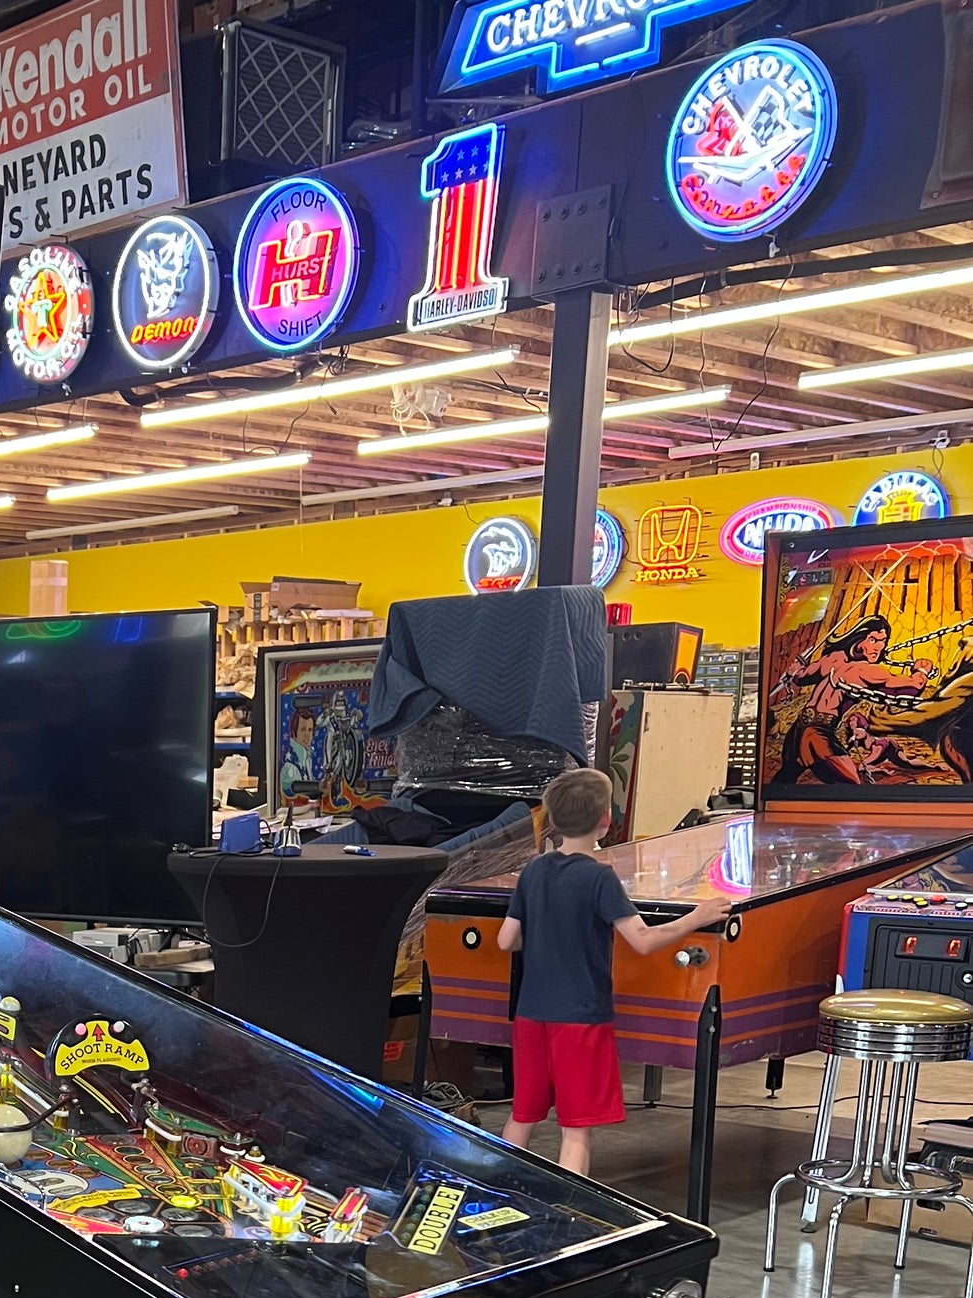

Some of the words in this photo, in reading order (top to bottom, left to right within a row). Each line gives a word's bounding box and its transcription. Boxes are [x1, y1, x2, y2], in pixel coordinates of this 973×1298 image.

[487, 0, 669, 51] CHEVR
[104, 64, 152, 106] OIL
[682, 55, 812, 134] CHEVROLET
[35, 197, 51, 232] &
[62, 164, 153, 224] PARTS
[270, 190, 327, 223] FLOOR
[271, 256, 332, 282] HURST
[130, 316, 195, 345] DEMON
[278, 311, 323, 337] SHIFT
[635, 567, 699, 582] HONDA
[60, 1043, 102, 1070] SHOOT
[105, 1043, 144, 1064] RAMP
[413, 1190, 460, 1251] DOUBLE
